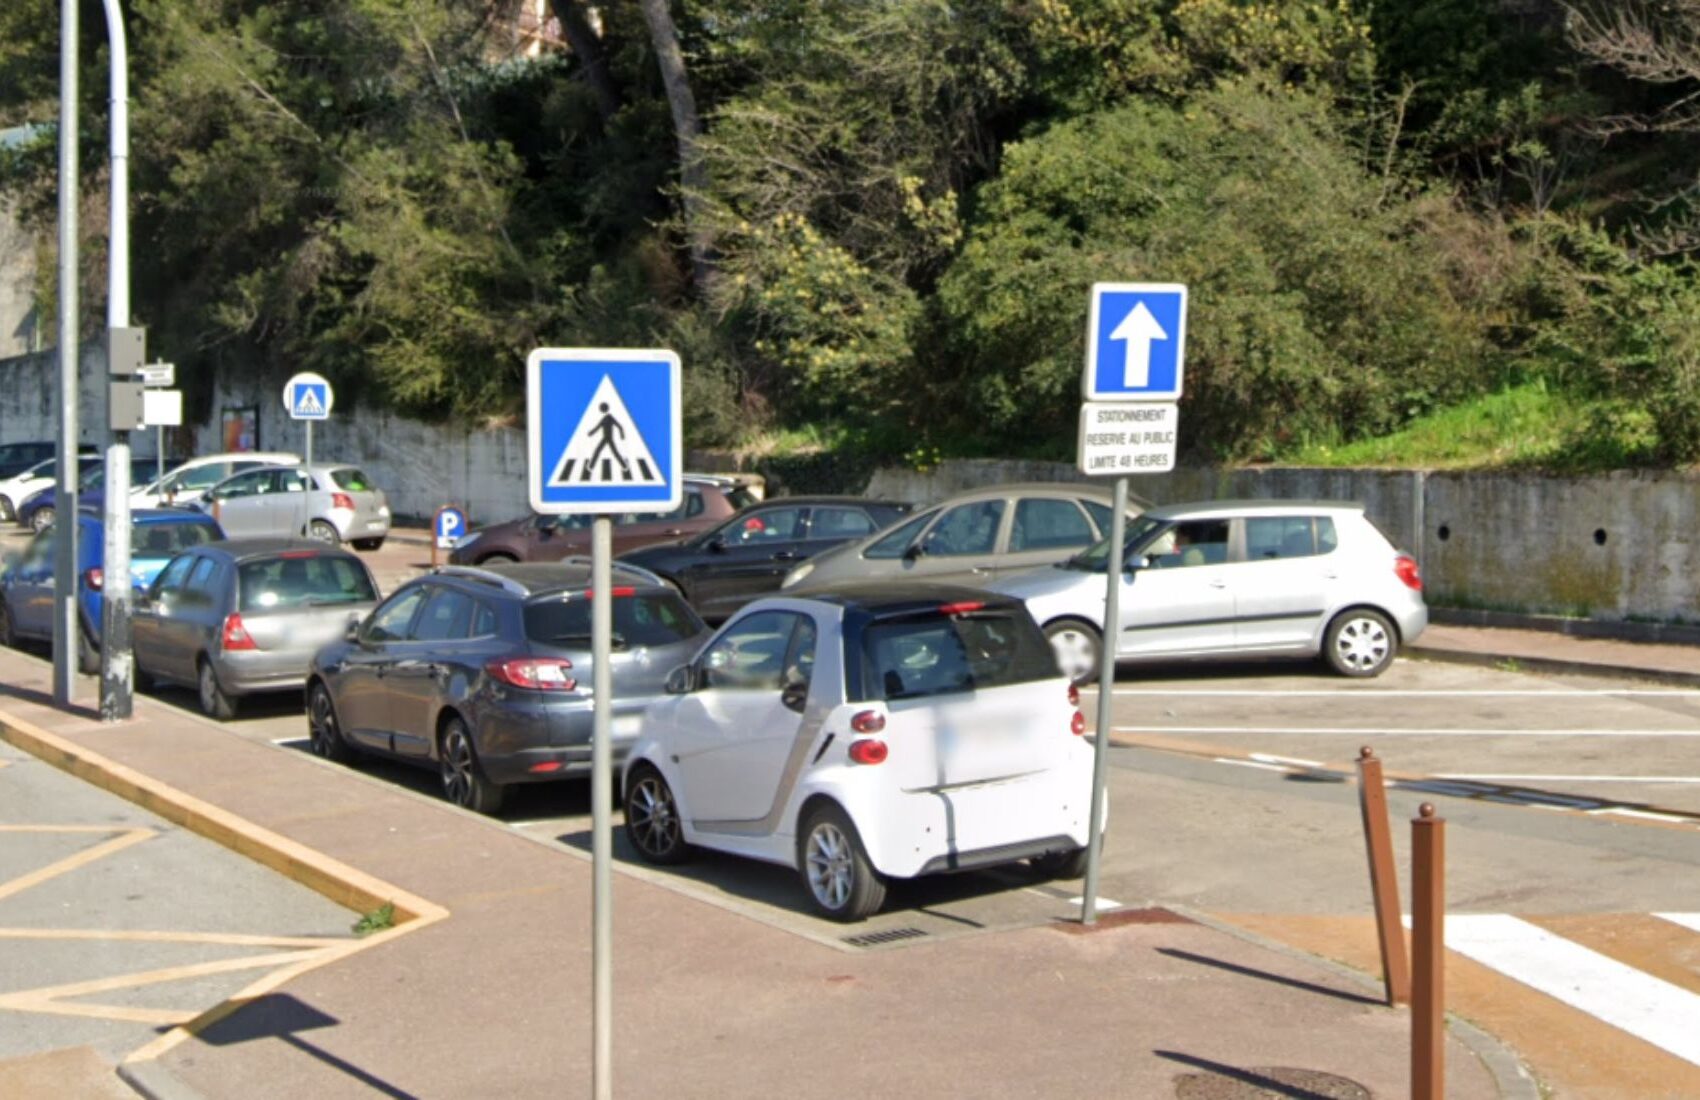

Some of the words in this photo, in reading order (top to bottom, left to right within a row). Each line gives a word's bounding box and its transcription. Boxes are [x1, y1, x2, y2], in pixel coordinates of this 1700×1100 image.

[1097, 409, 1166, 422] STATIONNEMENT
[1087, 432, 1126, 445] RESERVE
[1129, 432, 1141, 445] AU
[1144, 431, 1174, 443] PUBLIC
[1090, 455, 1116, 468] LIMITE
[1120, 454, 1131, 467] 48
[1134, 454, 1168, 466] HEURES
[442, 511, 458, 536] P
